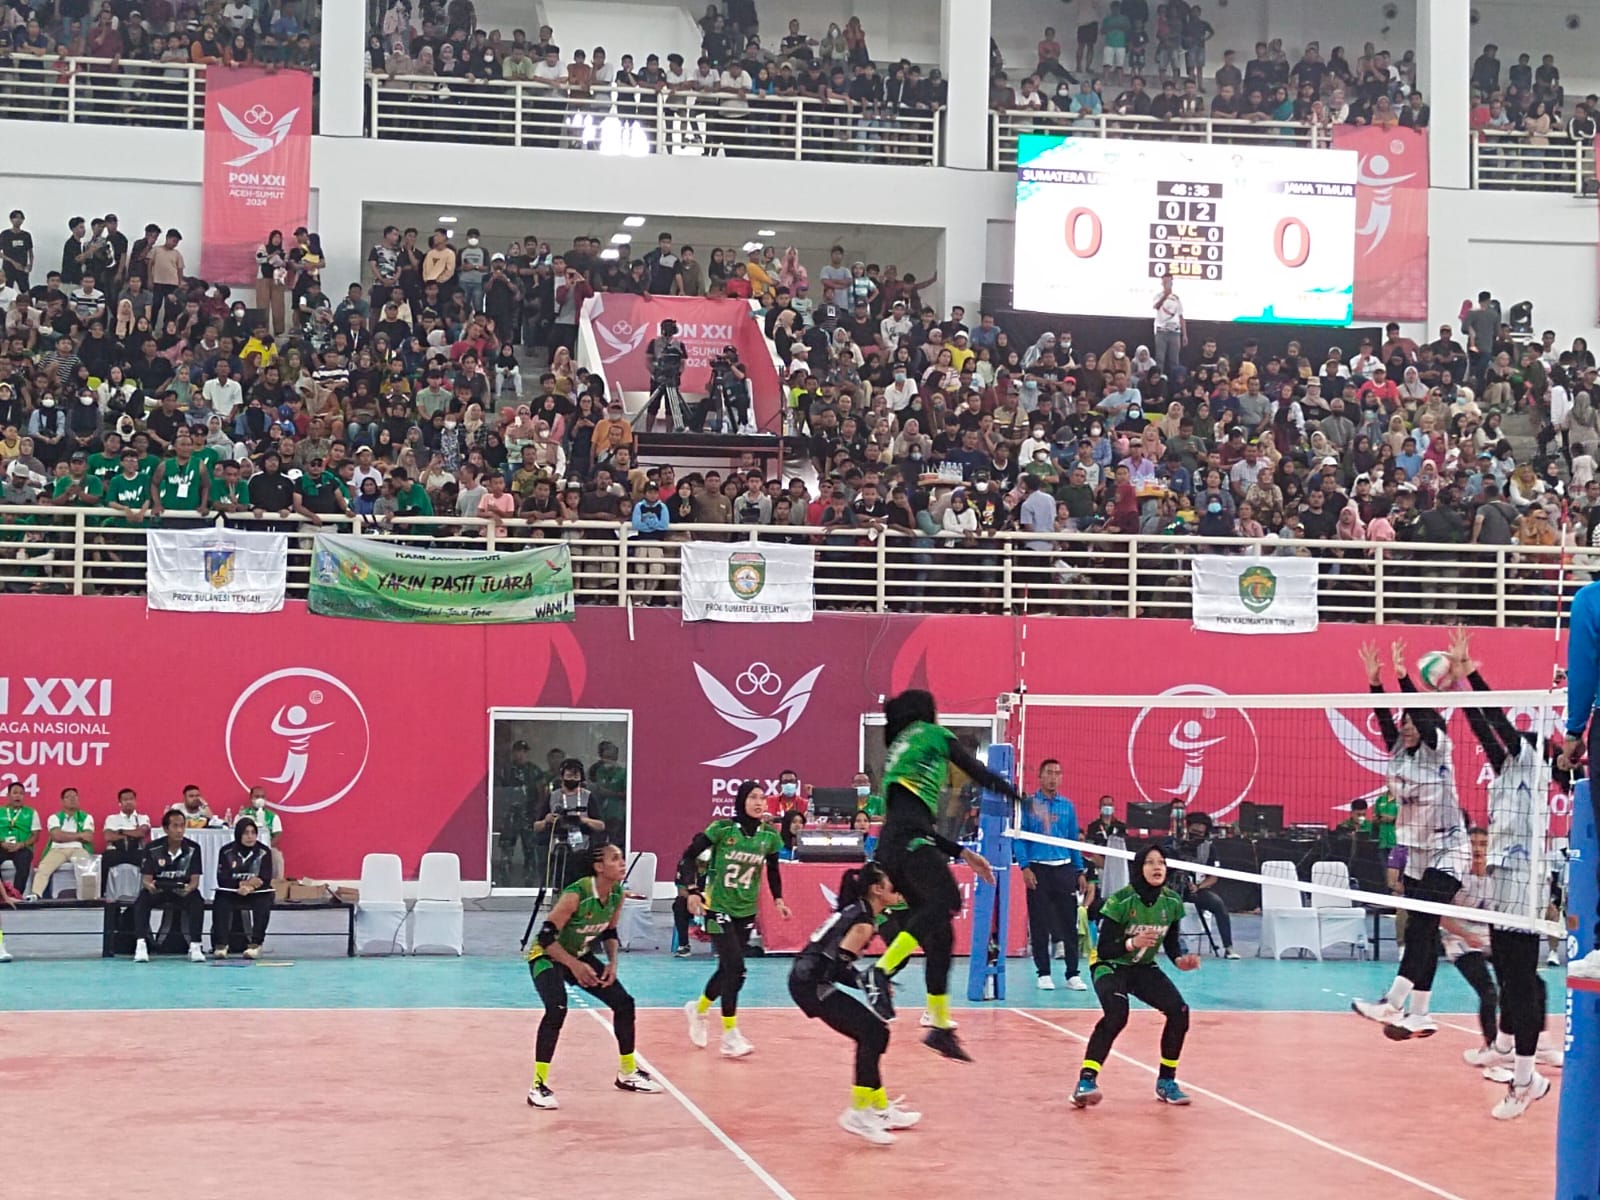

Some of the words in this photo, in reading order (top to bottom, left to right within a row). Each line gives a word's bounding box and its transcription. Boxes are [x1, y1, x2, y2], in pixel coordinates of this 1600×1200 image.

[229, 172, 259, 186] PON
[262, 174, 286, 187] XXI
[1021, 169, 1086, 184] SUMATERA
[229, 189, 285, 200] ACEH-SUMUT
[1315, 184, 1354, 197] TIMUR
[1165, 201, 1181, 220] 0
[1195, 203, 1211, 221] 2
[1064, 206, 1103, 259] 0
[1155, 224, 1168, 240] 0
[1176, 225, 1199, 237] VC
[1207, 227, 1220, 242] 0
[1273, 216, 1311, 269] 0
[1154, 243, 1167, 258] 0
[1207, 245, 1219, 261] 0
[1153, 262, 1166, 278] 0
[1168, 262, 1203, 276] SUB
[1206, 264, 1218, 280] 0
[701, 324, 733, 340] XXI
[685, 358, 708, 368] 024
[376, 572, 427, 592] YAKIN
[431, 574, 476, 593] PASTI
[480, 572, 533, 593] JUARA
[22, 677, 113, 717] XXI
[33, 722, 112, 735] NASIONAL
[724, 863, 756, 890] 24
